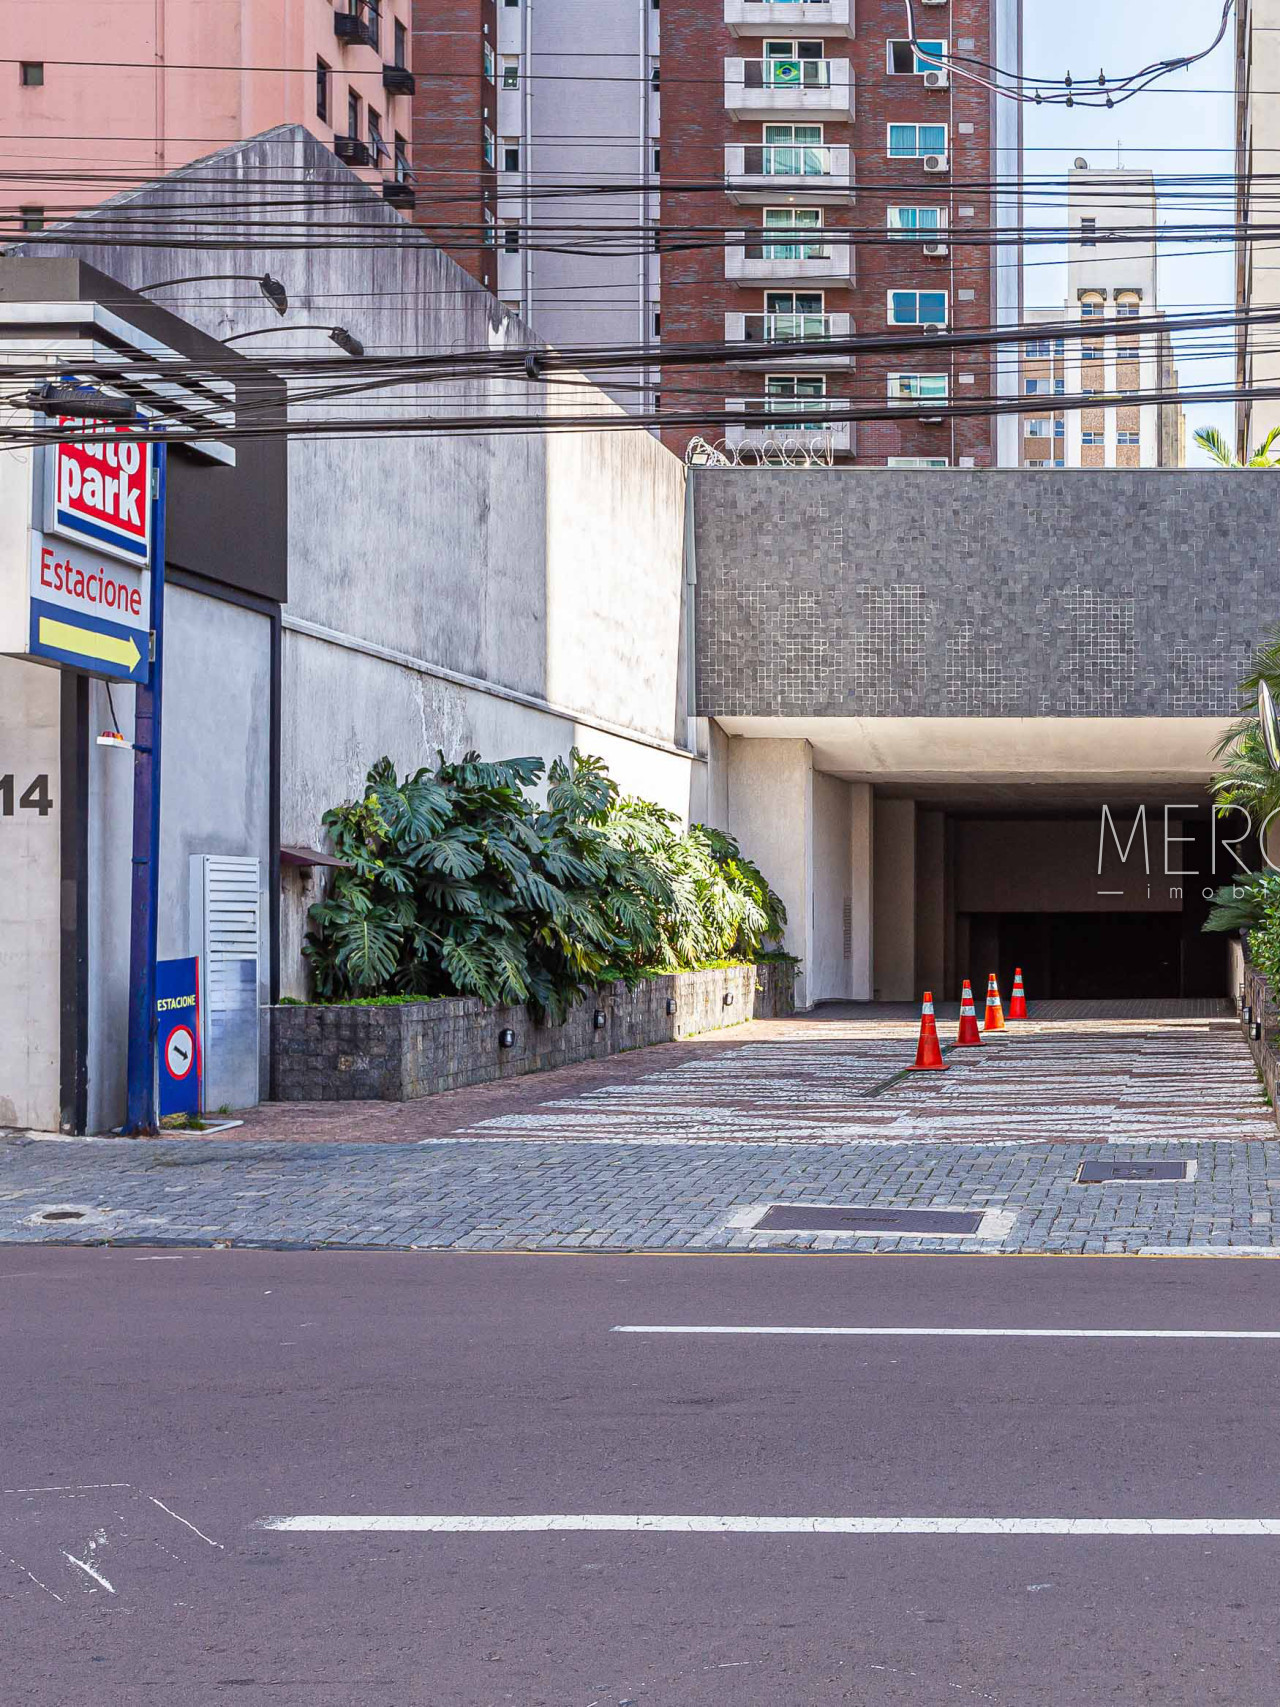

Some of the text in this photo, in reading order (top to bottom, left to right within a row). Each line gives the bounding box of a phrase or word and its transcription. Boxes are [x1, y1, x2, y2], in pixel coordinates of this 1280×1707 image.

[60, 454, 141, 526] park
[40, 547, 142, 616] Estacione
[0, 774, 53, 816] 14
[157, 994, 196, 1012] ESTACIONE
